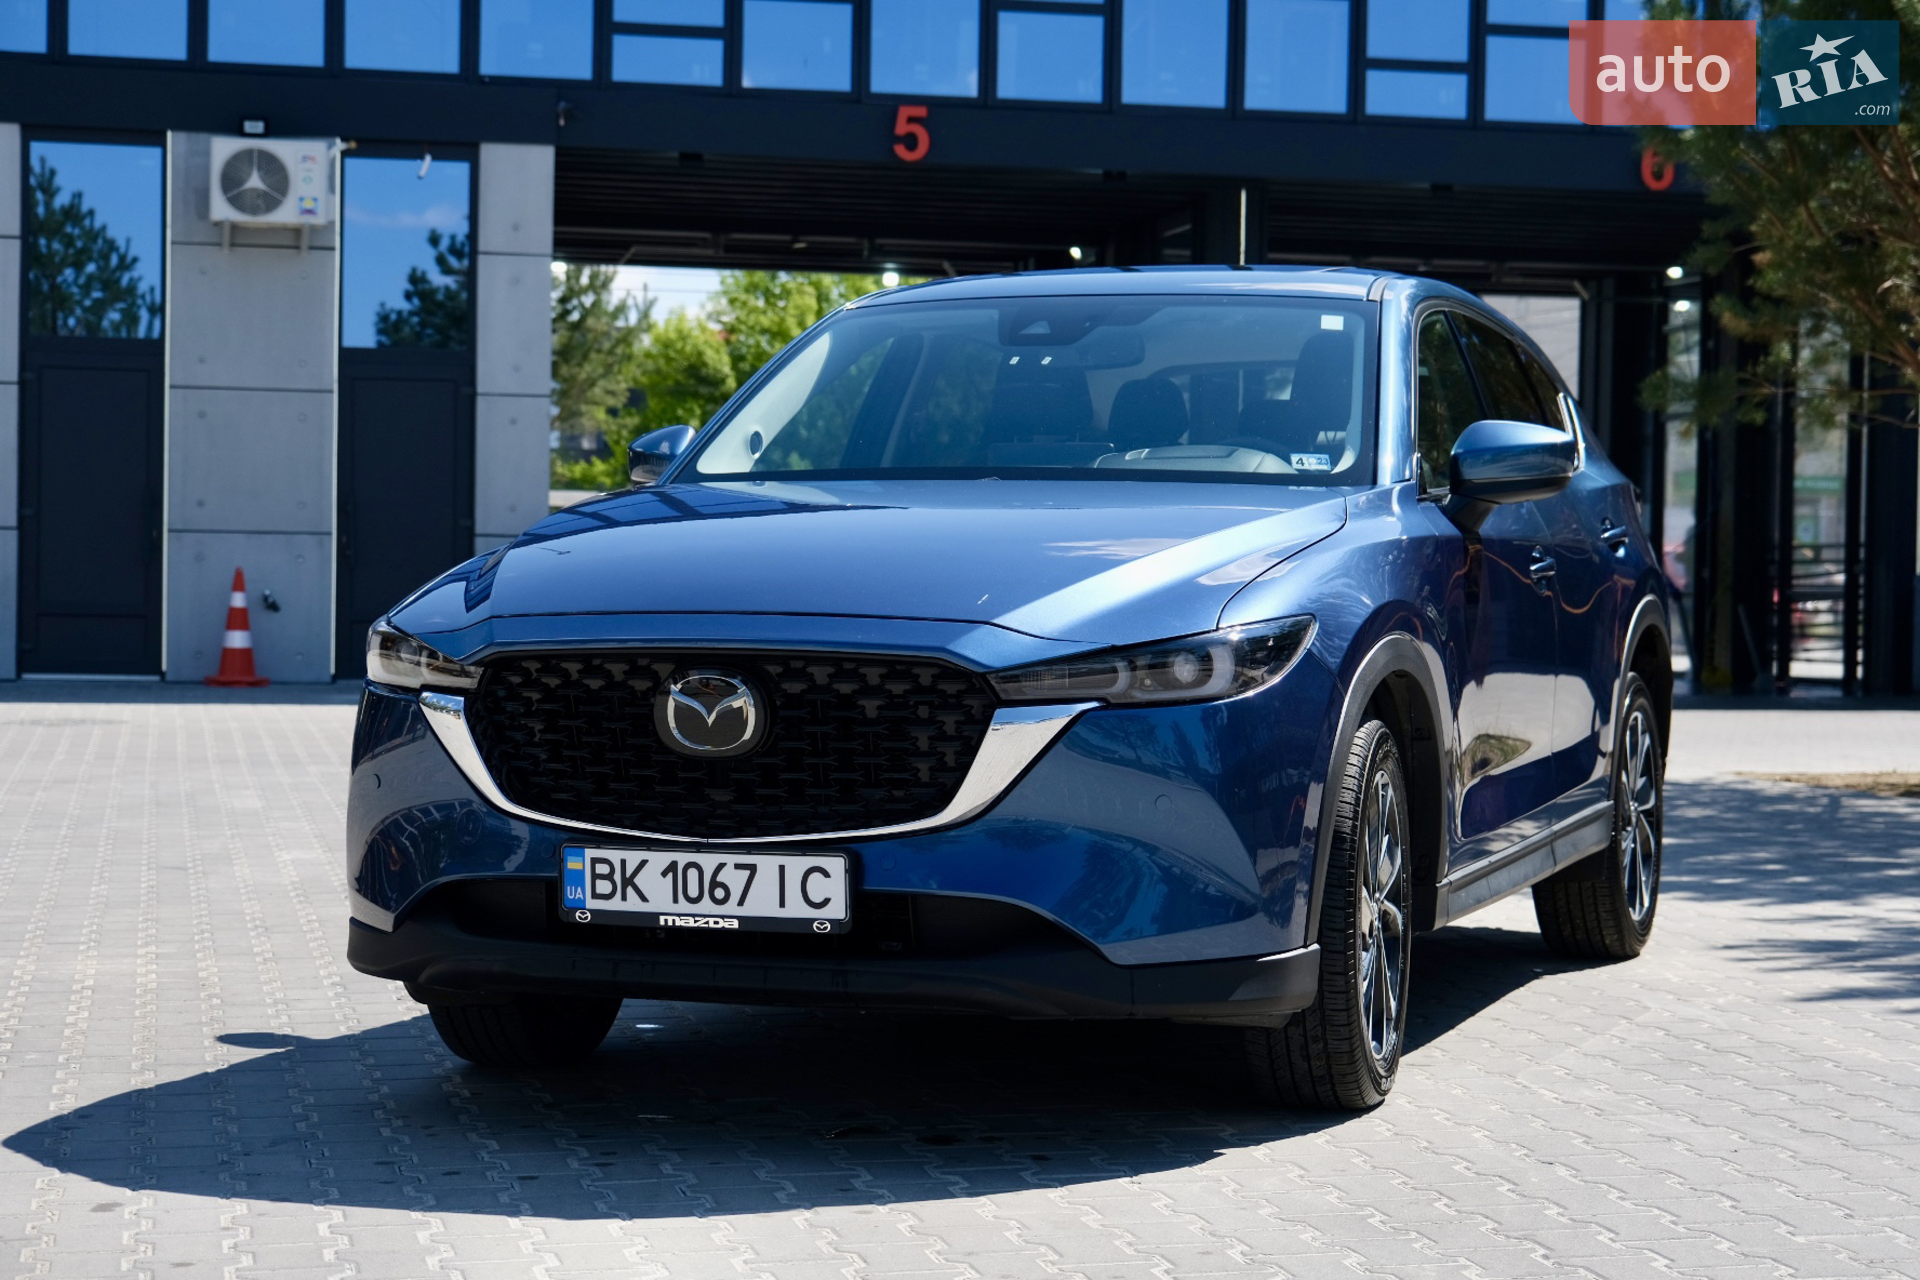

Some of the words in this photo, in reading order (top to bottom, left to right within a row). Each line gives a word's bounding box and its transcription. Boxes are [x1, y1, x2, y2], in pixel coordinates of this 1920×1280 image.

[893, 105, 930, 162] 5
[1296, 457, 1305, 466] 4
[1317, 457, 1329, 465] 23
[567, 885, 584, 900] UA
[589, 856, 650, 903] BK
[660, 860, 758, 907] 1067
